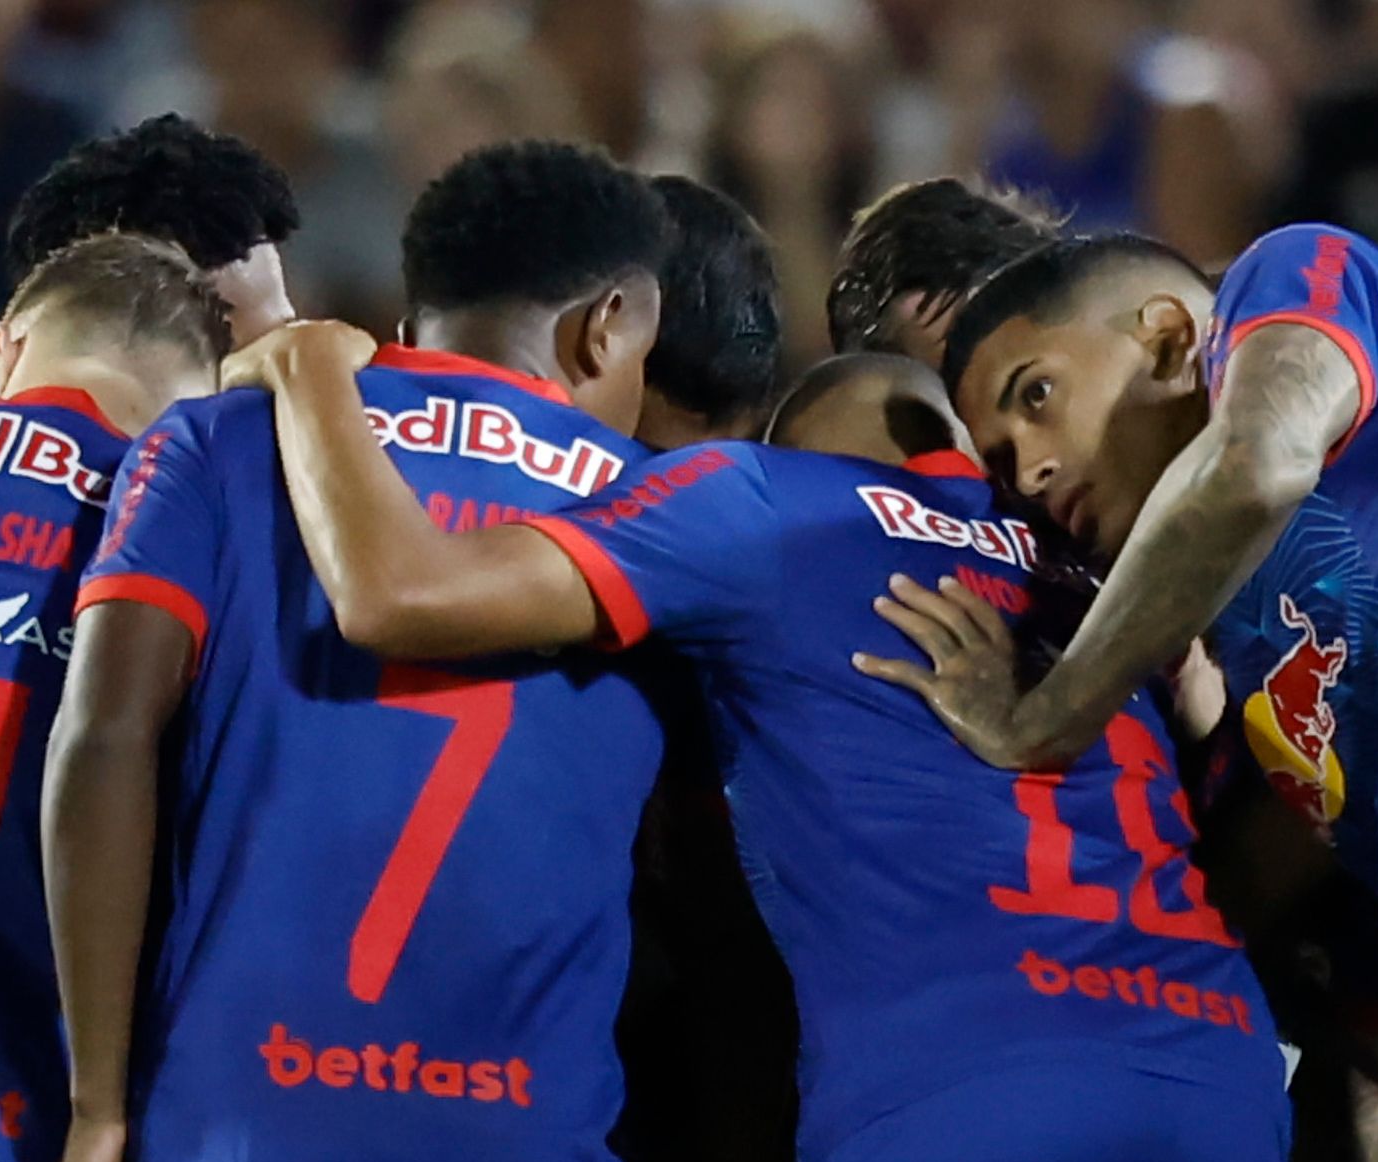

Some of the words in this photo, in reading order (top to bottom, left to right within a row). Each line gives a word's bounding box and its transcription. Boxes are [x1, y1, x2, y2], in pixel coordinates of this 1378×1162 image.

[459, 403, 624, 498] Bull
[345, 662, 516, 1005] 7
[1015, 949, 1254, 1035] betfast
[259, 1022, 533, 1108] betfast
